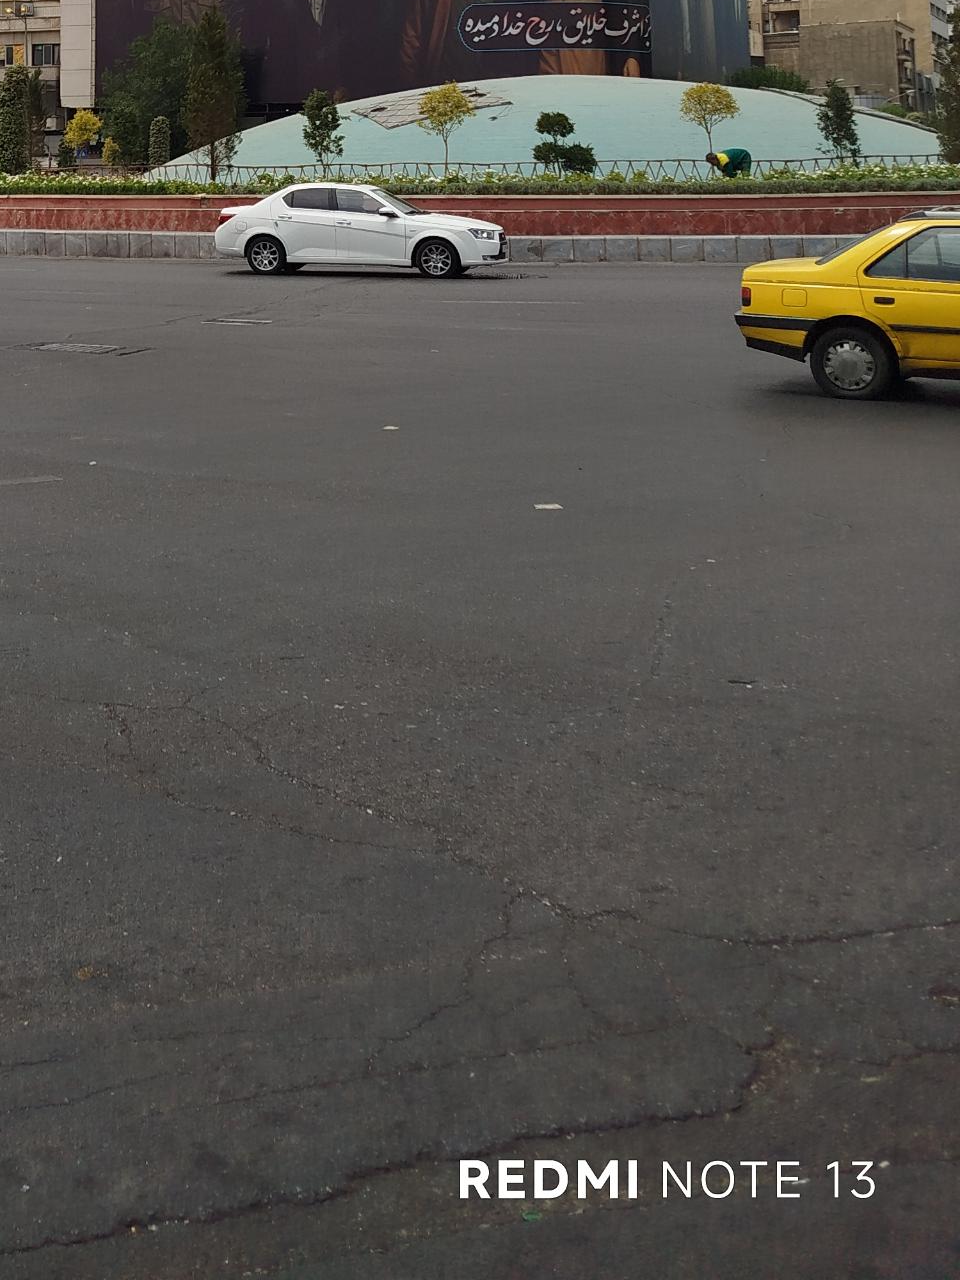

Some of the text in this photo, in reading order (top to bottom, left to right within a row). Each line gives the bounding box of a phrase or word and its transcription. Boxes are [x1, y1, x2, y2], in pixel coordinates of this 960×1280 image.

[465, 14, 500, 42] دمیده
[501, 11, 526, 37] خدا
[525, 16, 555, 46] روح
[604, 8, 644, 45] اشرف
